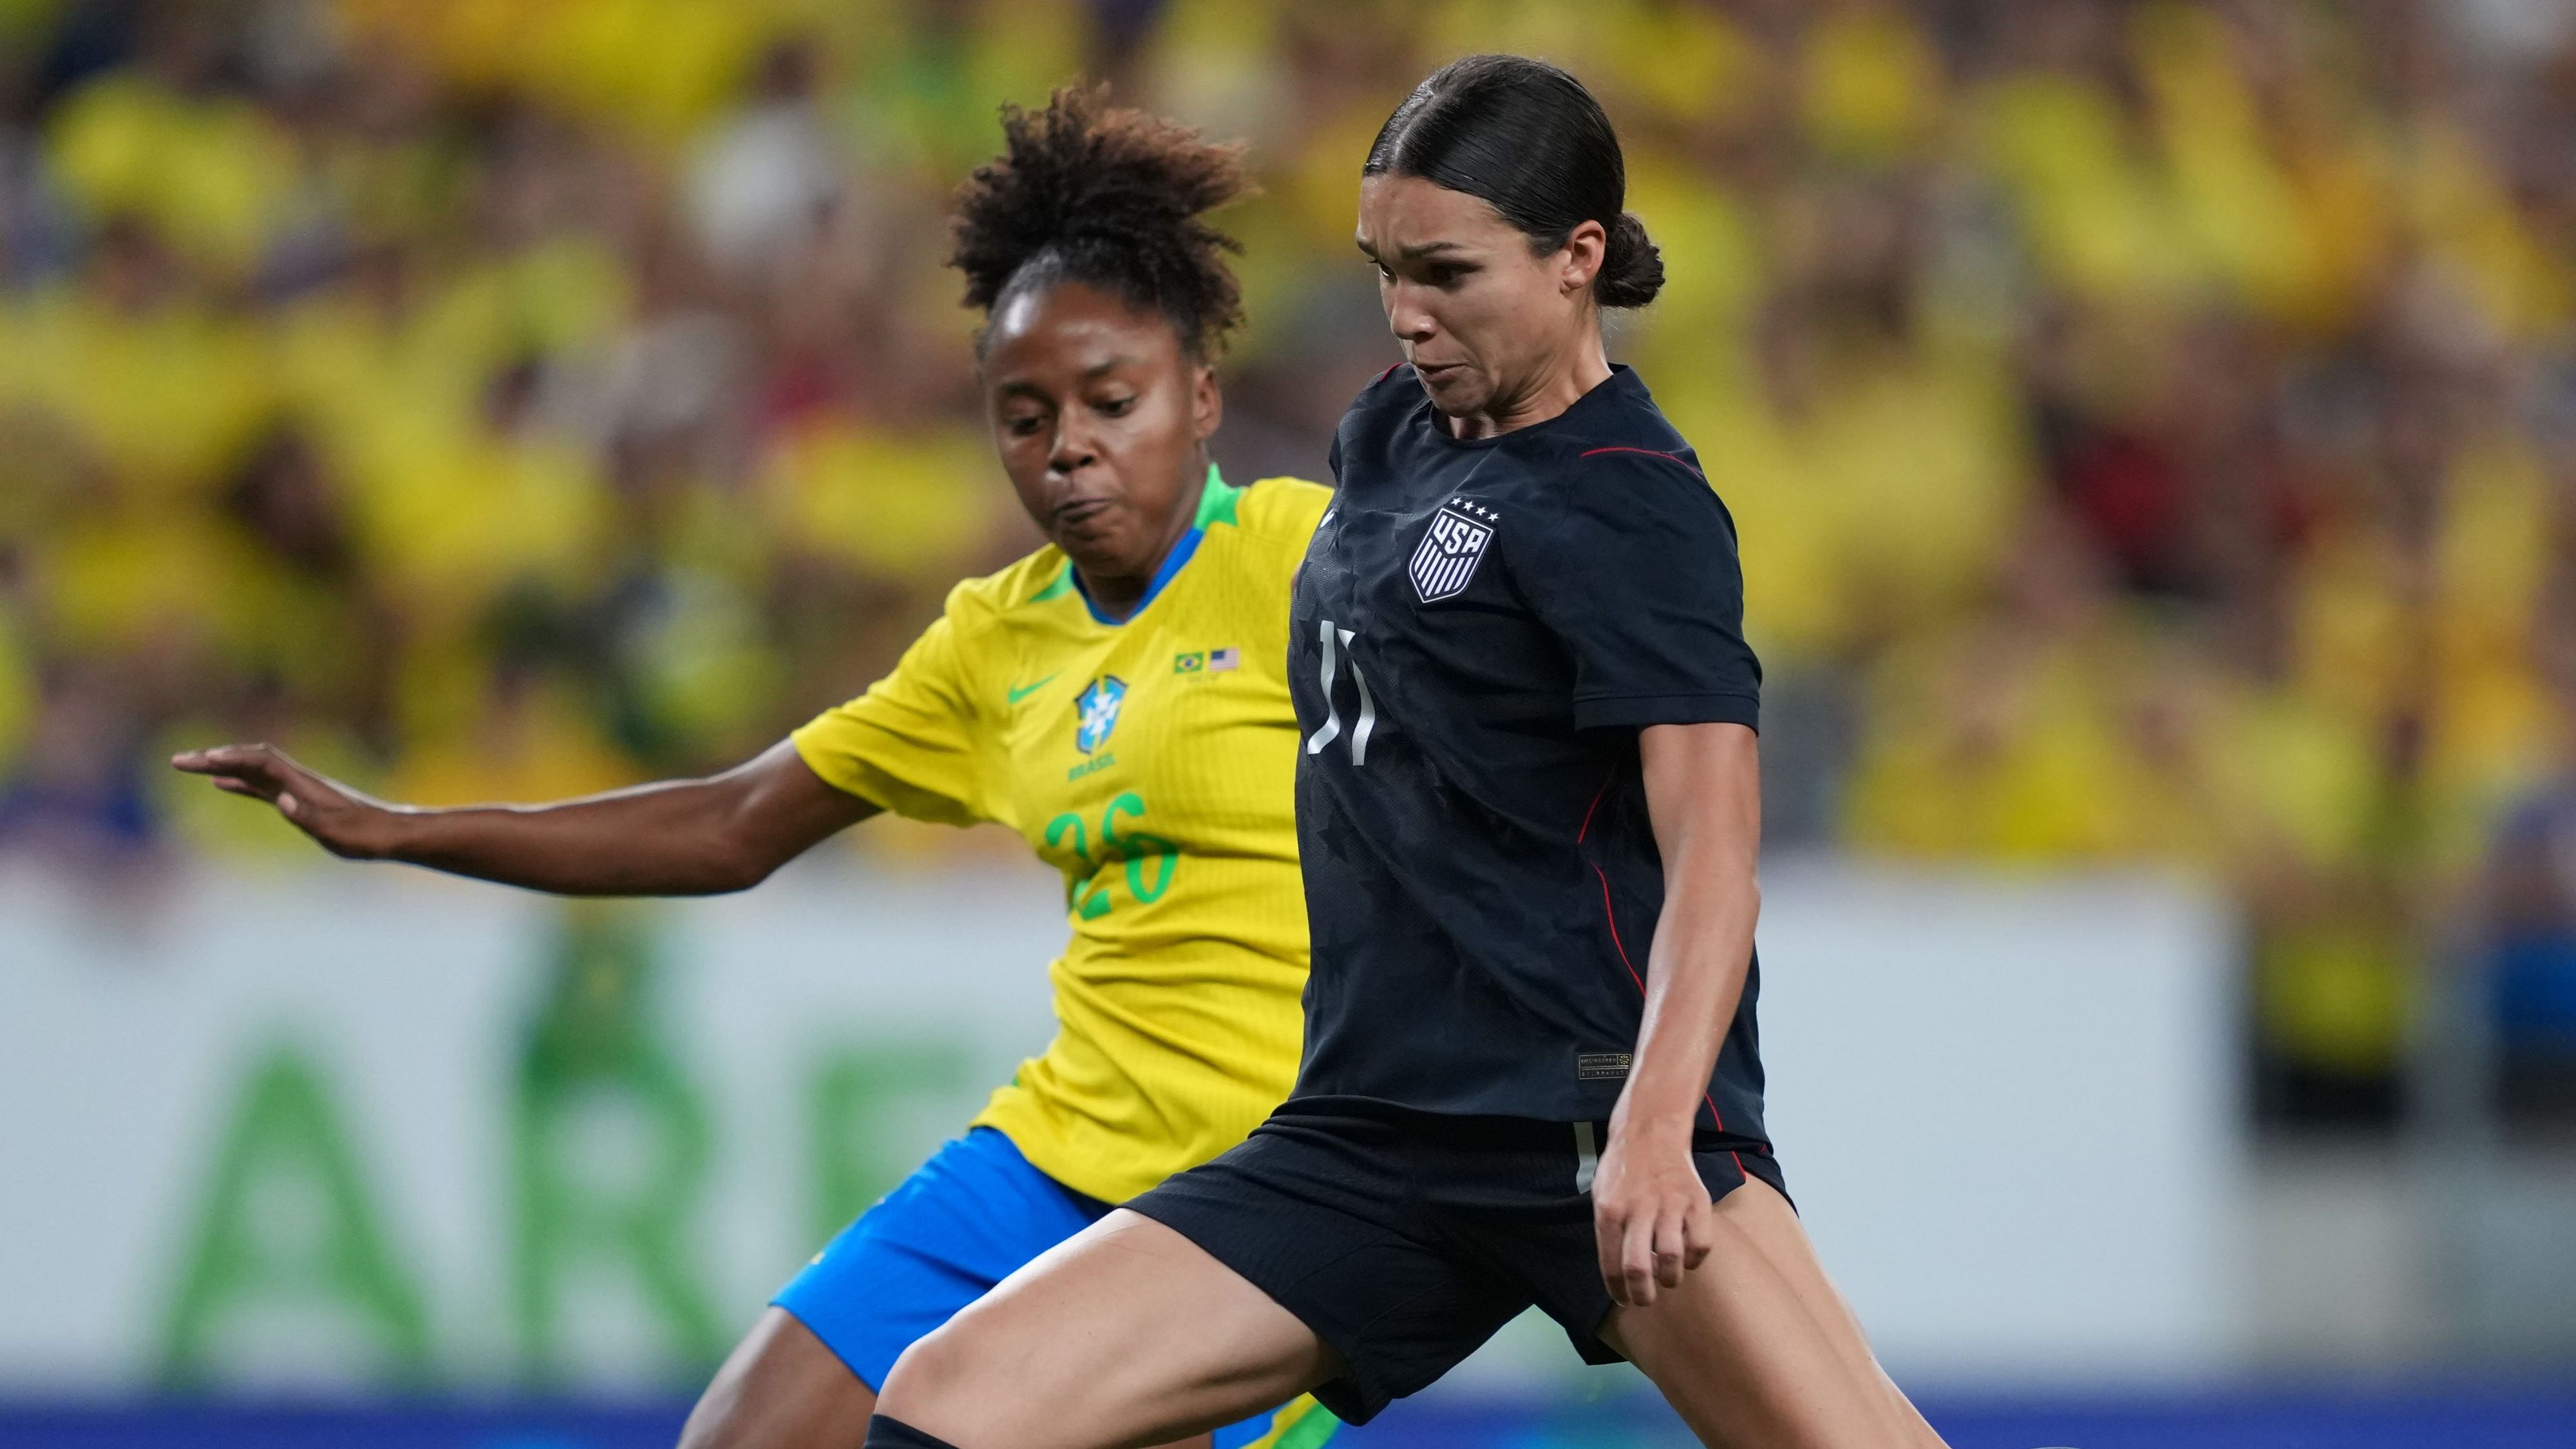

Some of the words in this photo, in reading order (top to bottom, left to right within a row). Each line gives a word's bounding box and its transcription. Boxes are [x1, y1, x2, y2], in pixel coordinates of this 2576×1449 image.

[1433, 515, 1486, 554] USA
[1307, 620, 1376, 766] 11
[1067, 752, 1116, 782] BRASIL
[1045, 792, 1179, 921] 26
